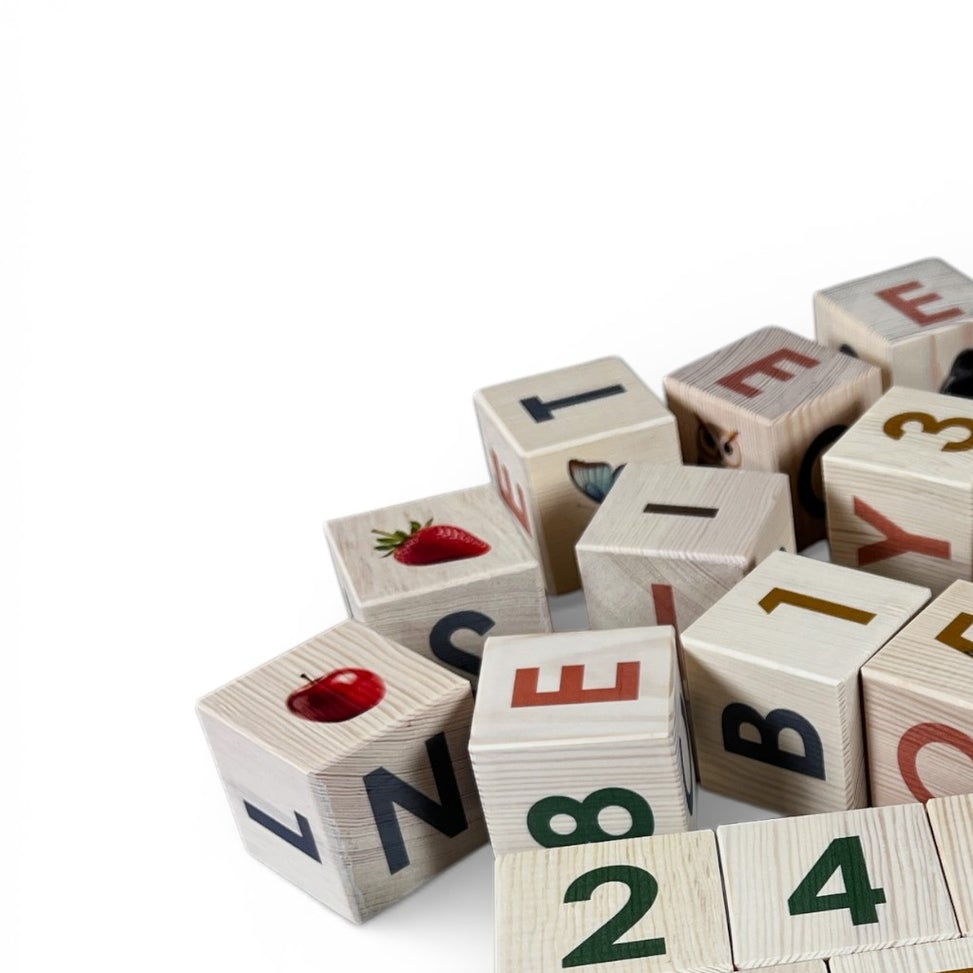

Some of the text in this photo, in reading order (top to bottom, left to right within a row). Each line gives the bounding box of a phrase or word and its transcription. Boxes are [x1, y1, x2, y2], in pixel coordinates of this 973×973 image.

[876, 281, 964, 327] E
[520, 384, 626, 424] T
[716, 347, 820, 399] E
[853, 496, 953, 566] Y
[511, 660, 640, 708] E
[721, 702, 826, 781] B
[363, 731, 468, 876] N
[526, 786, 655, 849] 8
[562, 864, 667, 968] 2
[788, 835, 887, 926] 4
